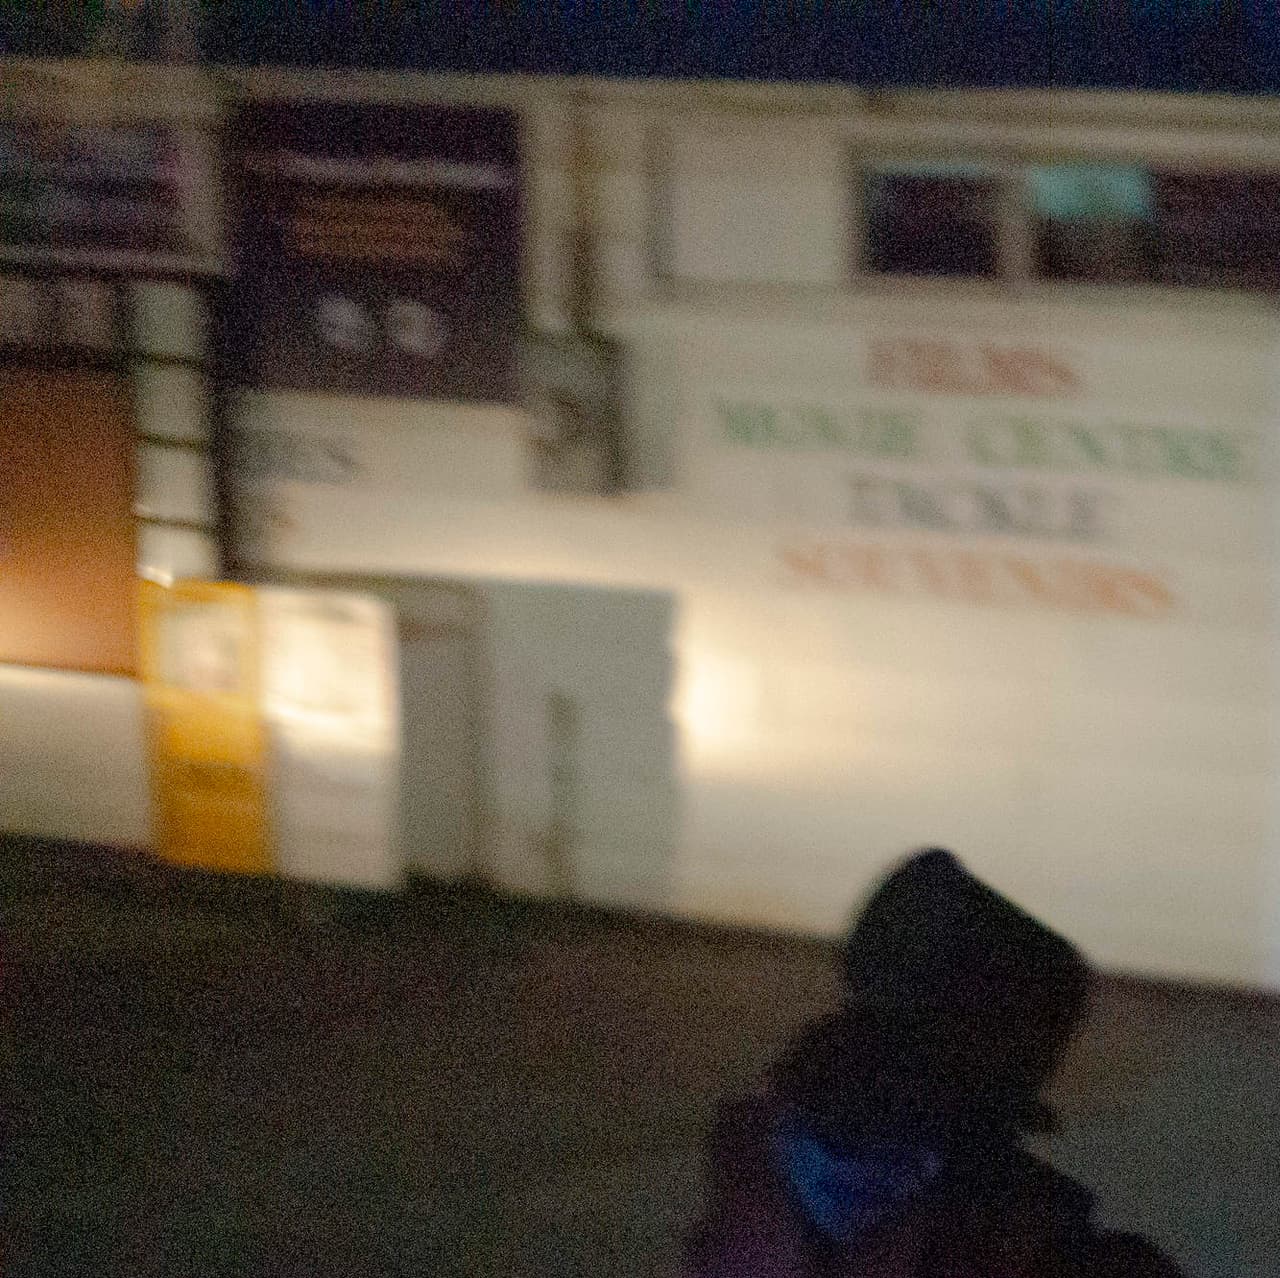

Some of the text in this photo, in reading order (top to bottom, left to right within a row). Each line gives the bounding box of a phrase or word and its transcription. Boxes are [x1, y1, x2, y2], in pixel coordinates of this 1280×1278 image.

[867, 337, 1082, 397] FILMS
[715, 399, 1250, 482] MOVIE CENTRE
[845, 473, 1112, 541] TACKLE
[777, 539, 1180, 618] SOUVENIRS
